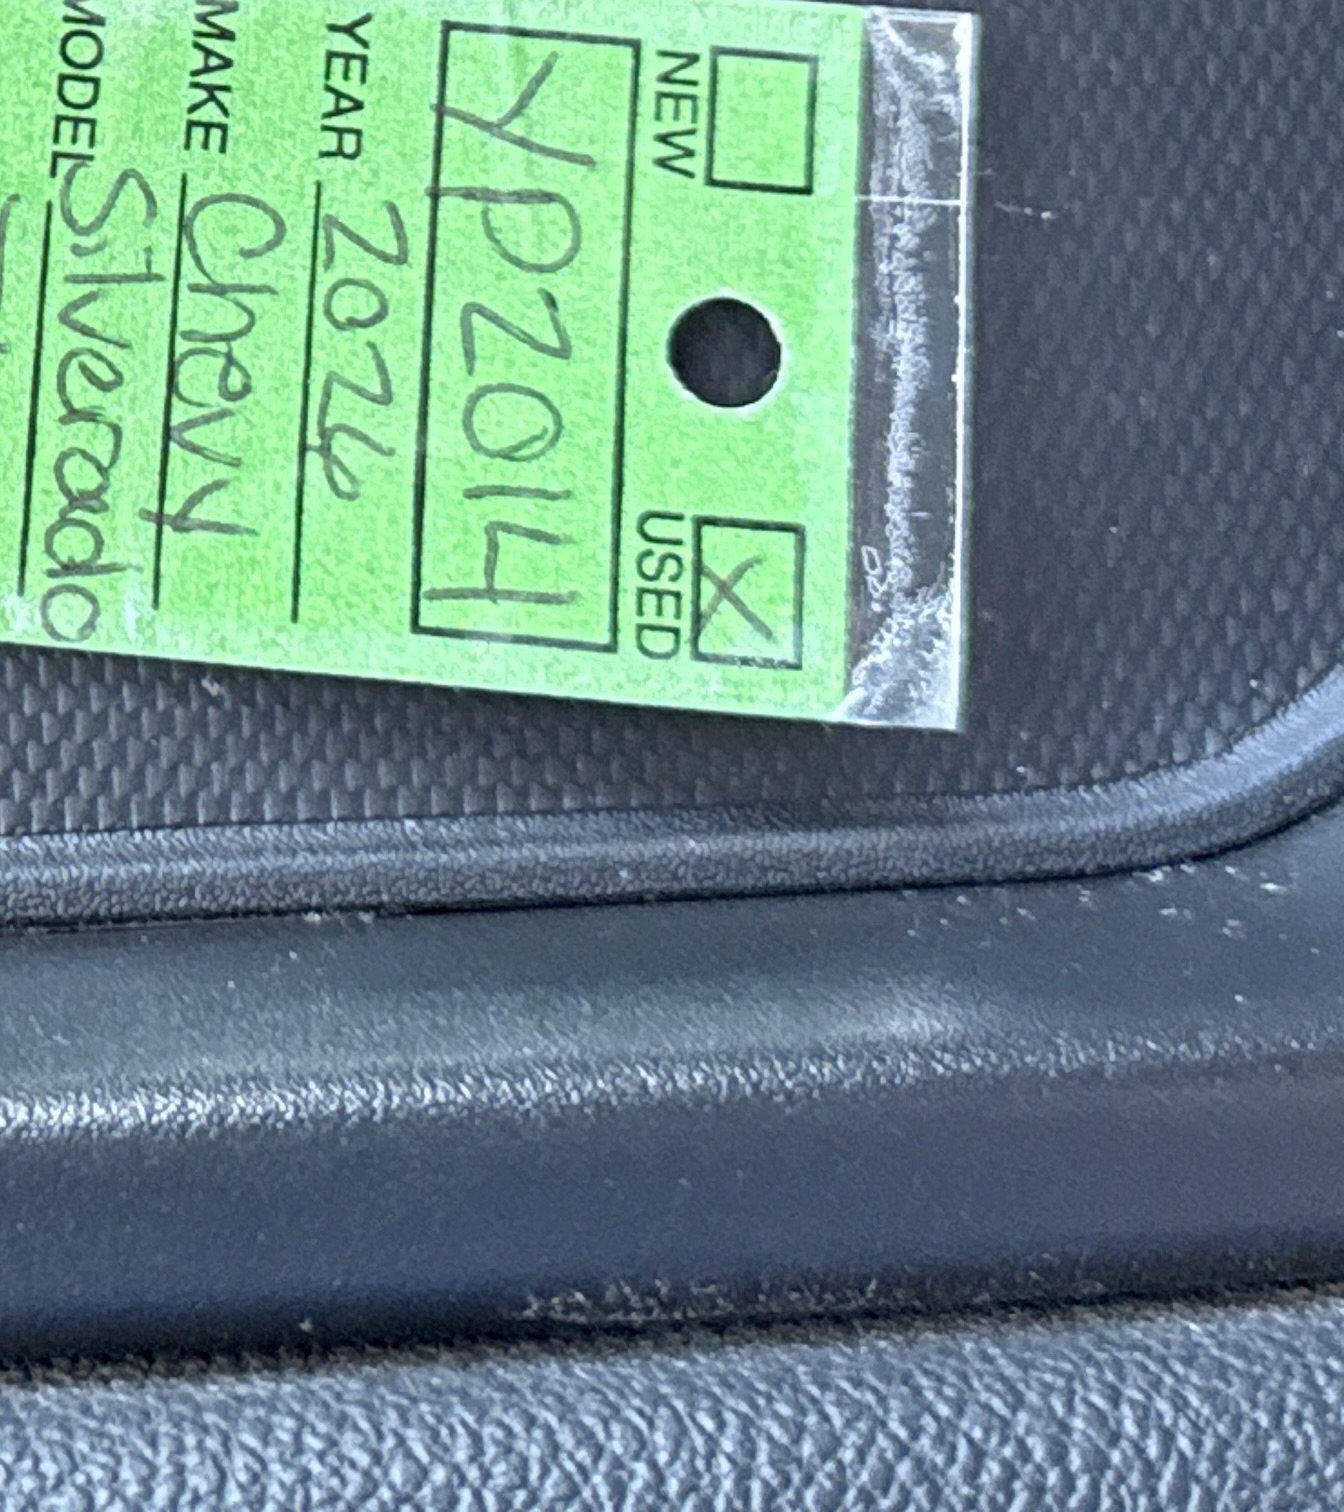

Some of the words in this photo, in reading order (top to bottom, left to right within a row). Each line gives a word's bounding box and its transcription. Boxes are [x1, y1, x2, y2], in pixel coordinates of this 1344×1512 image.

[318, 12, 374, 161] YEAR
[651, 49, 701, 180] NEW
[40, 161, 165, 643] Silverado
[139, 192, 287, 537] Chevy
[306, 200, 408, 502] 2026
[635, 509, 686, 660] USED
